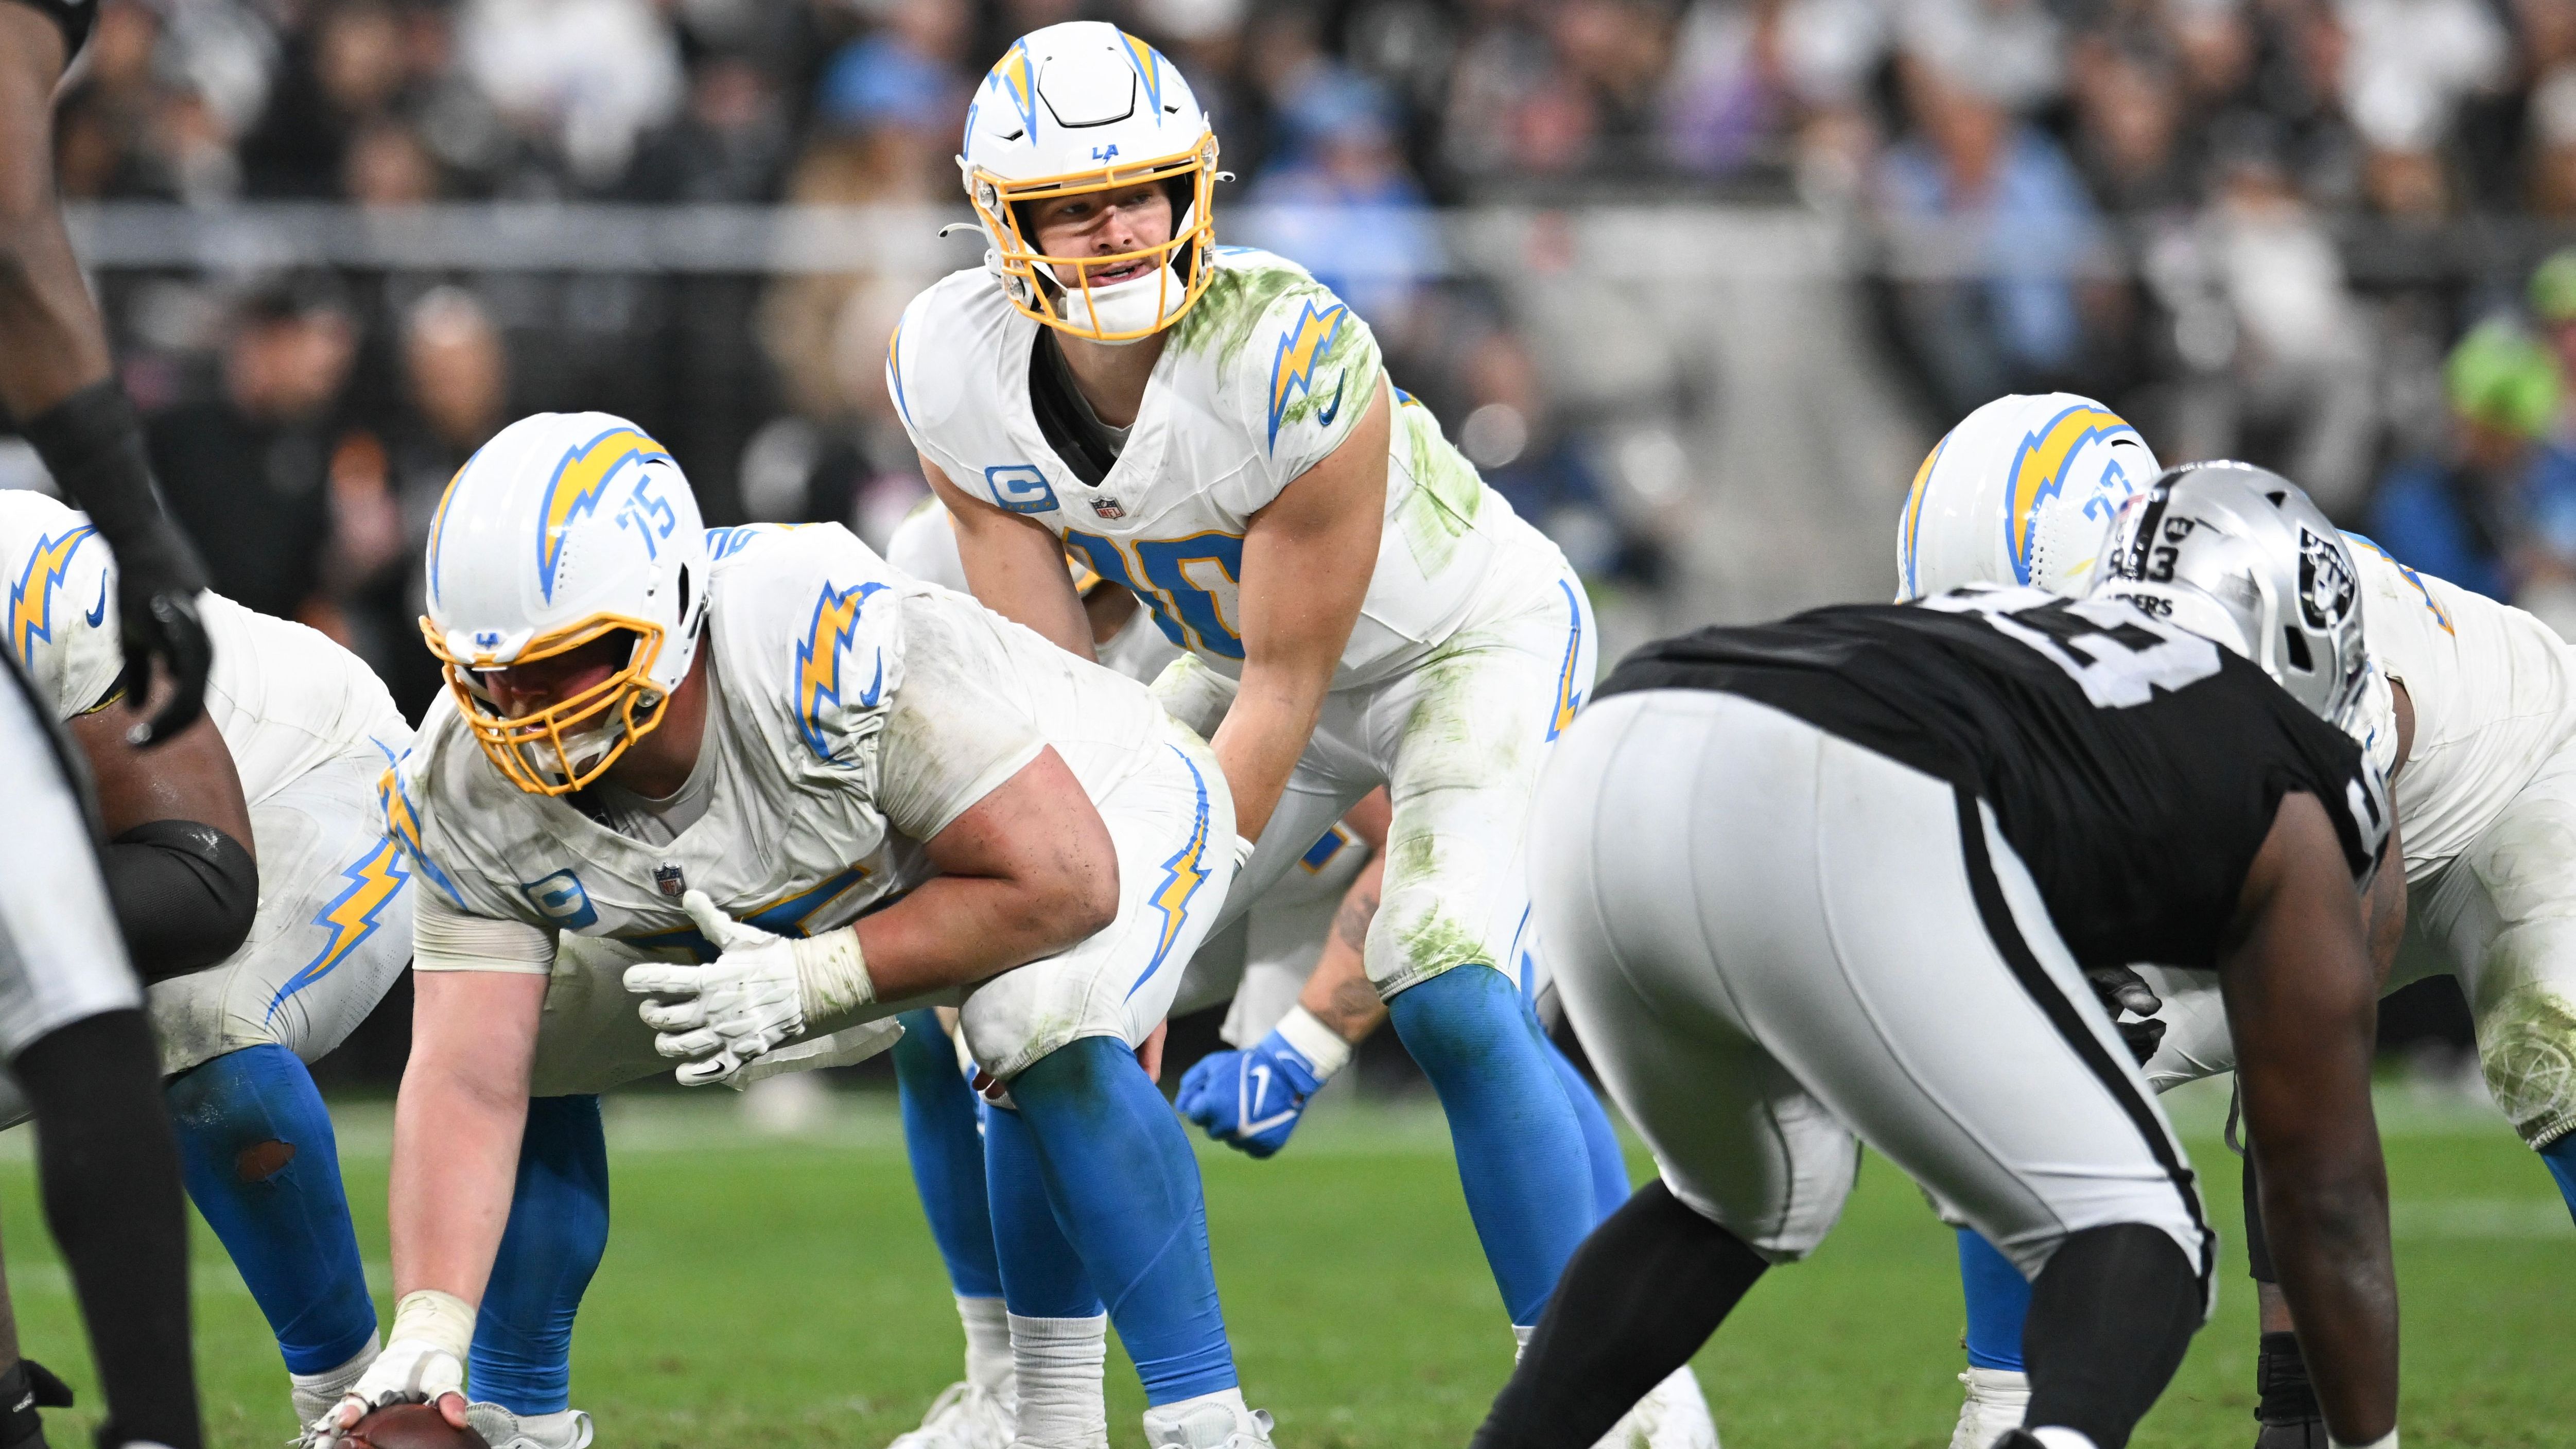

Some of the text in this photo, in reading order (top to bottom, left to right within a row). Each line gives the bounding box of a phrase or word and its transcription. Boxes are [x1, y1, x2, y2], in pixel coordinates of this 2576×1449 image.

[1092, 144, 1119, 165] LA
[992, 469, 1047, 503] C
[615, 474, 675, 562] 75
[476, 632, 499, 651] LA
[528, 876, 583, 918] C
